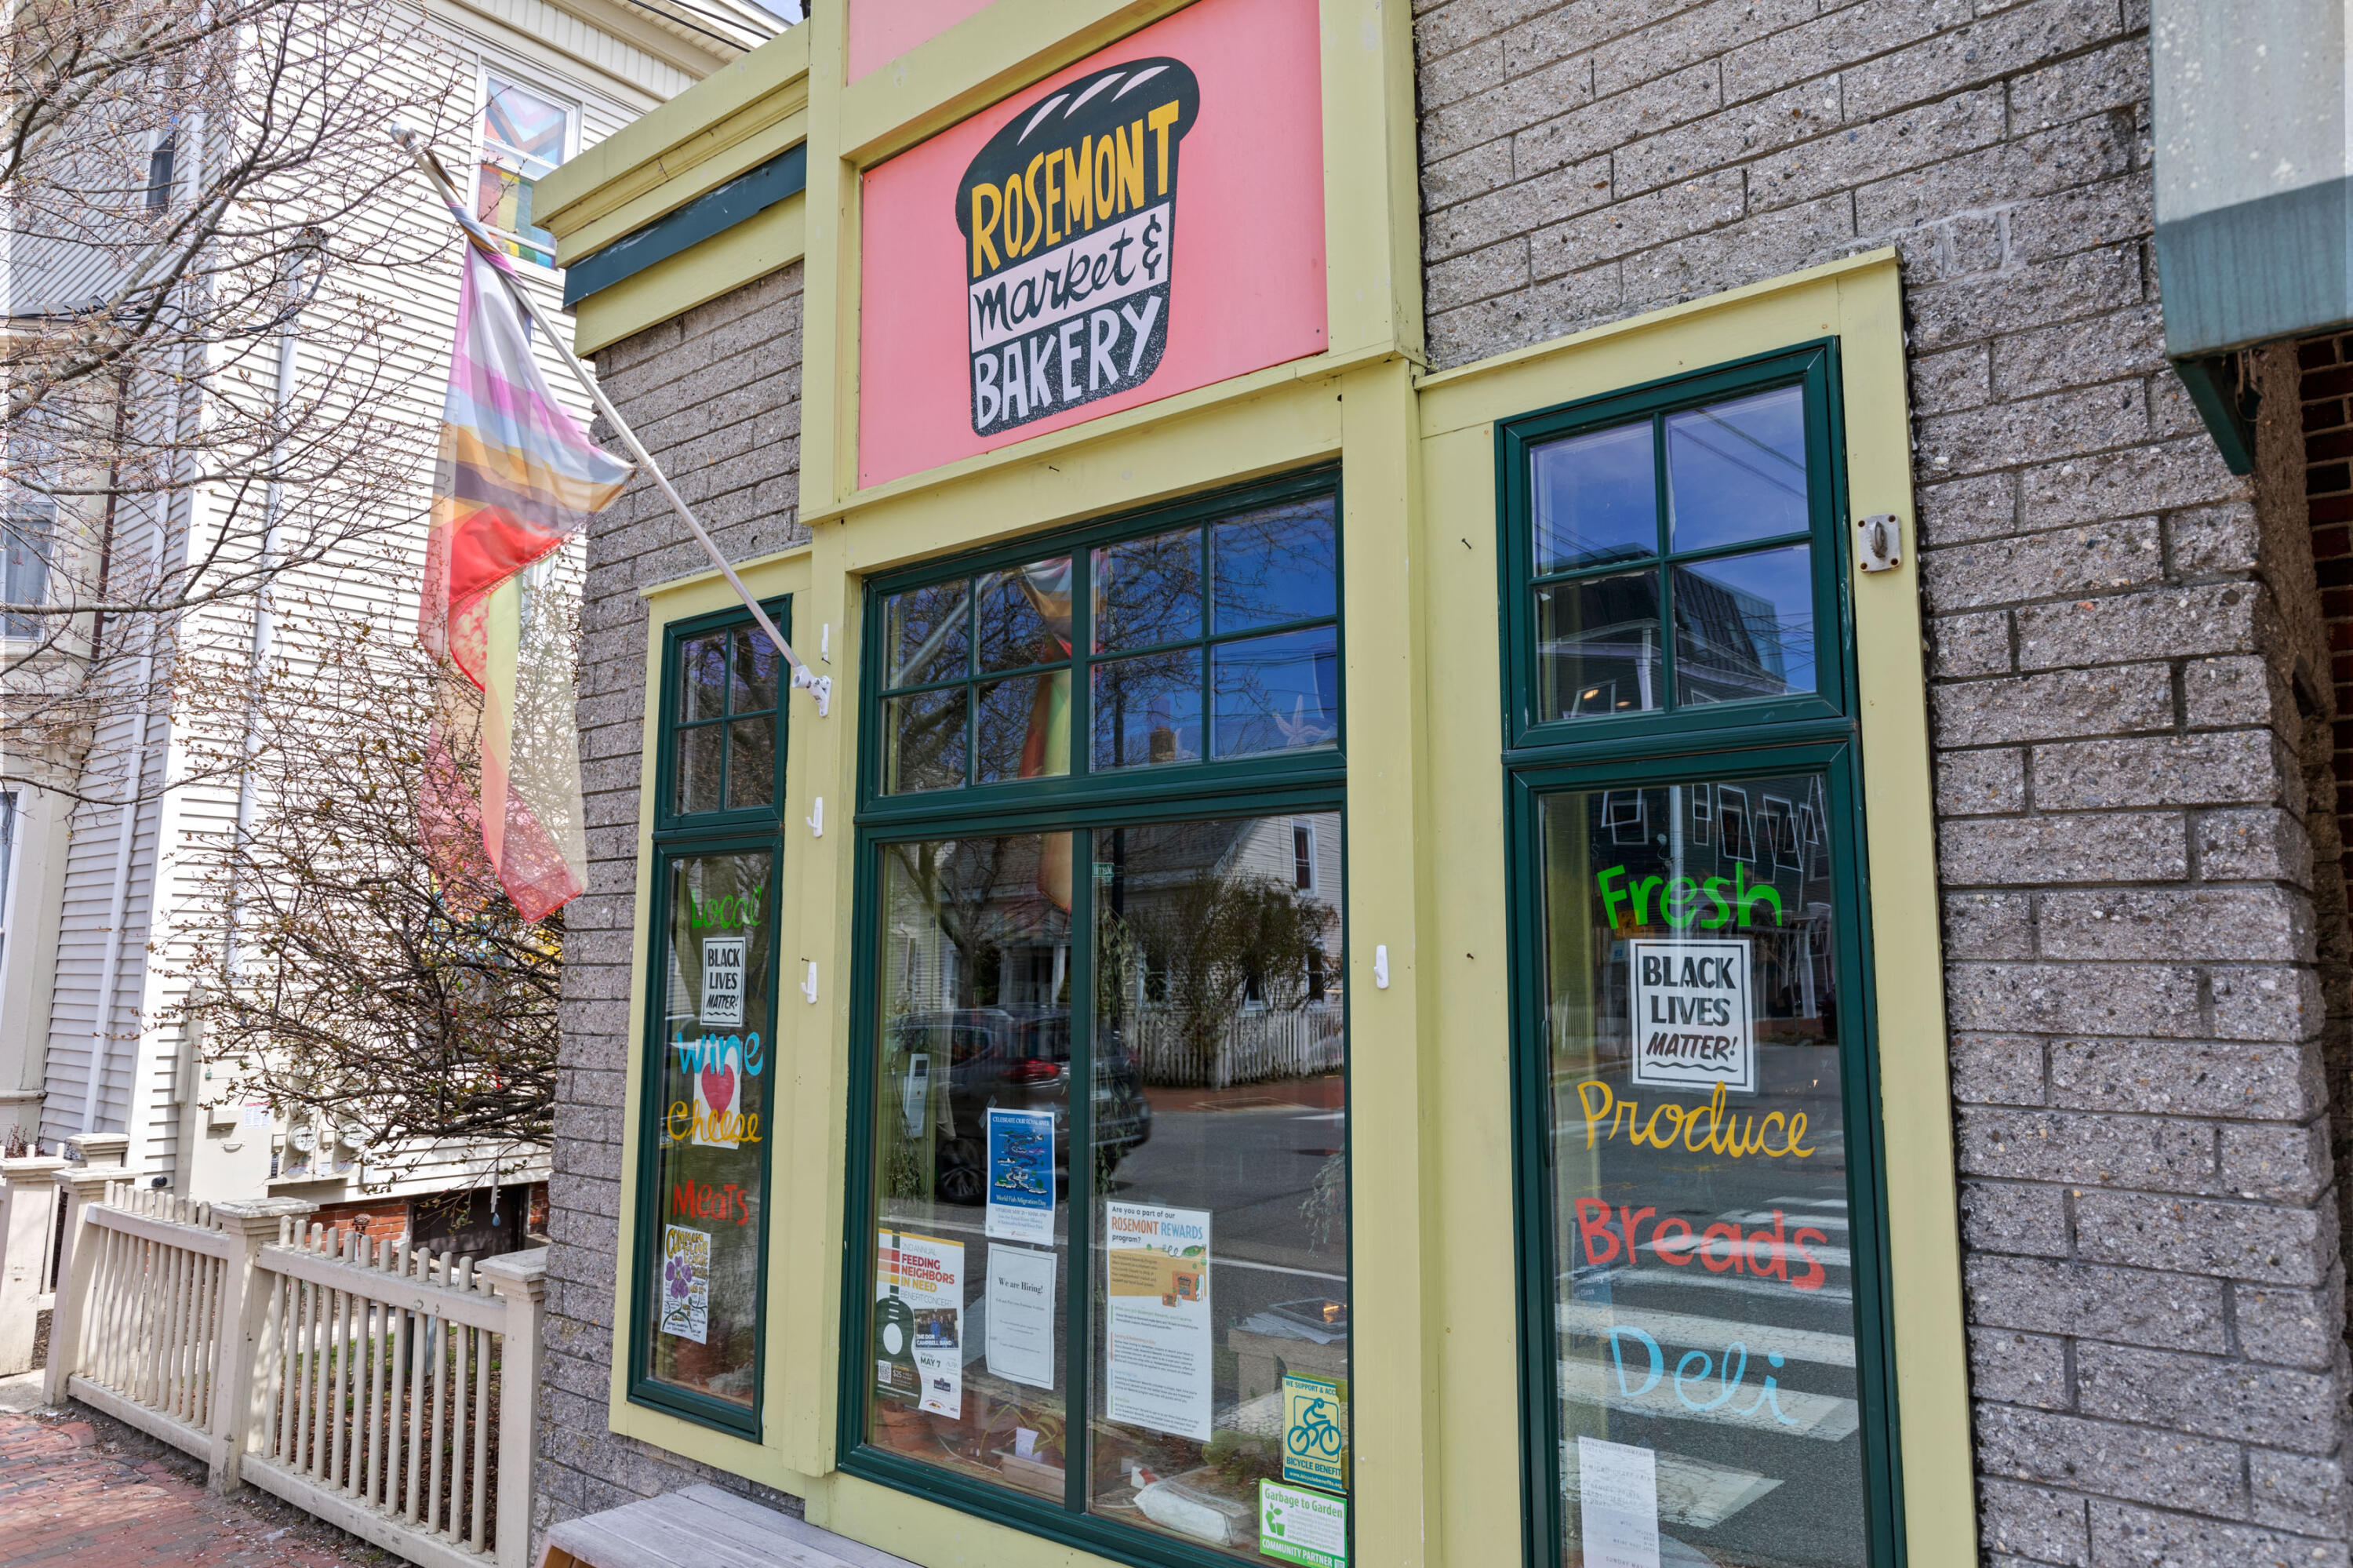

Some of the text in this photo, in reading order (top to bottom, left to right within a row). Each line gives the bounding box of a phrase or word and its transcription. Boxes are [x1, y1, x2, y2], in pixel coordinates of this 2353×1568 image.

[971, 100, 1180, 278] ROSEMONT
[1142, 214, 1162, 282] &
[974, 296, 1162, 430] BAKERY
[690, 885, 762, 930] Local
[1597, 861, 1782, 930] Fresh
[707, 948, 740, 967] BLACK
[1643, 955, 1737, 989] BLACK
[709, 972, 738, 989] LIVES
[706, 994, 739, 1010] MATTER!
[1650, 995, 1731, 1027] LIVES
[1646, 1031, 1738, 1061] MATTER!
[667, 1101, 763, 1144] Cheese
[1577, 1080, 1817, 1158] Produce
[1017, 1196, 1038, 1205] Migration
[1112, 1216, 1203, 1240] ROSEMONT REWARDS
[1112, 1234, 1141, 1242] program?
[1575, 1197, 1827, 1291] Breads
[901, 1264, 955, 1285] NEIGHBORS
[902, 1253, 940, 1270] FEEDING
[901, 1275, 937, 1293] IN NEED
[998, 1277, 1009, 1286] We
[1021, 1282, 1043, 1295] Hiring!
[920, 1355, 936, 1366] MAY
[1603, 1325, 1800, 1425] Deli
[1295, 1382, 1318, 1392] SUPPORT
[1287, 1456, 1313, 1470] BICYCLE
[1265, 1488, 1343, 1519] Garbage to Garden
[1262, 1538, 1332, 1567] COMMUNITY PARTNER
